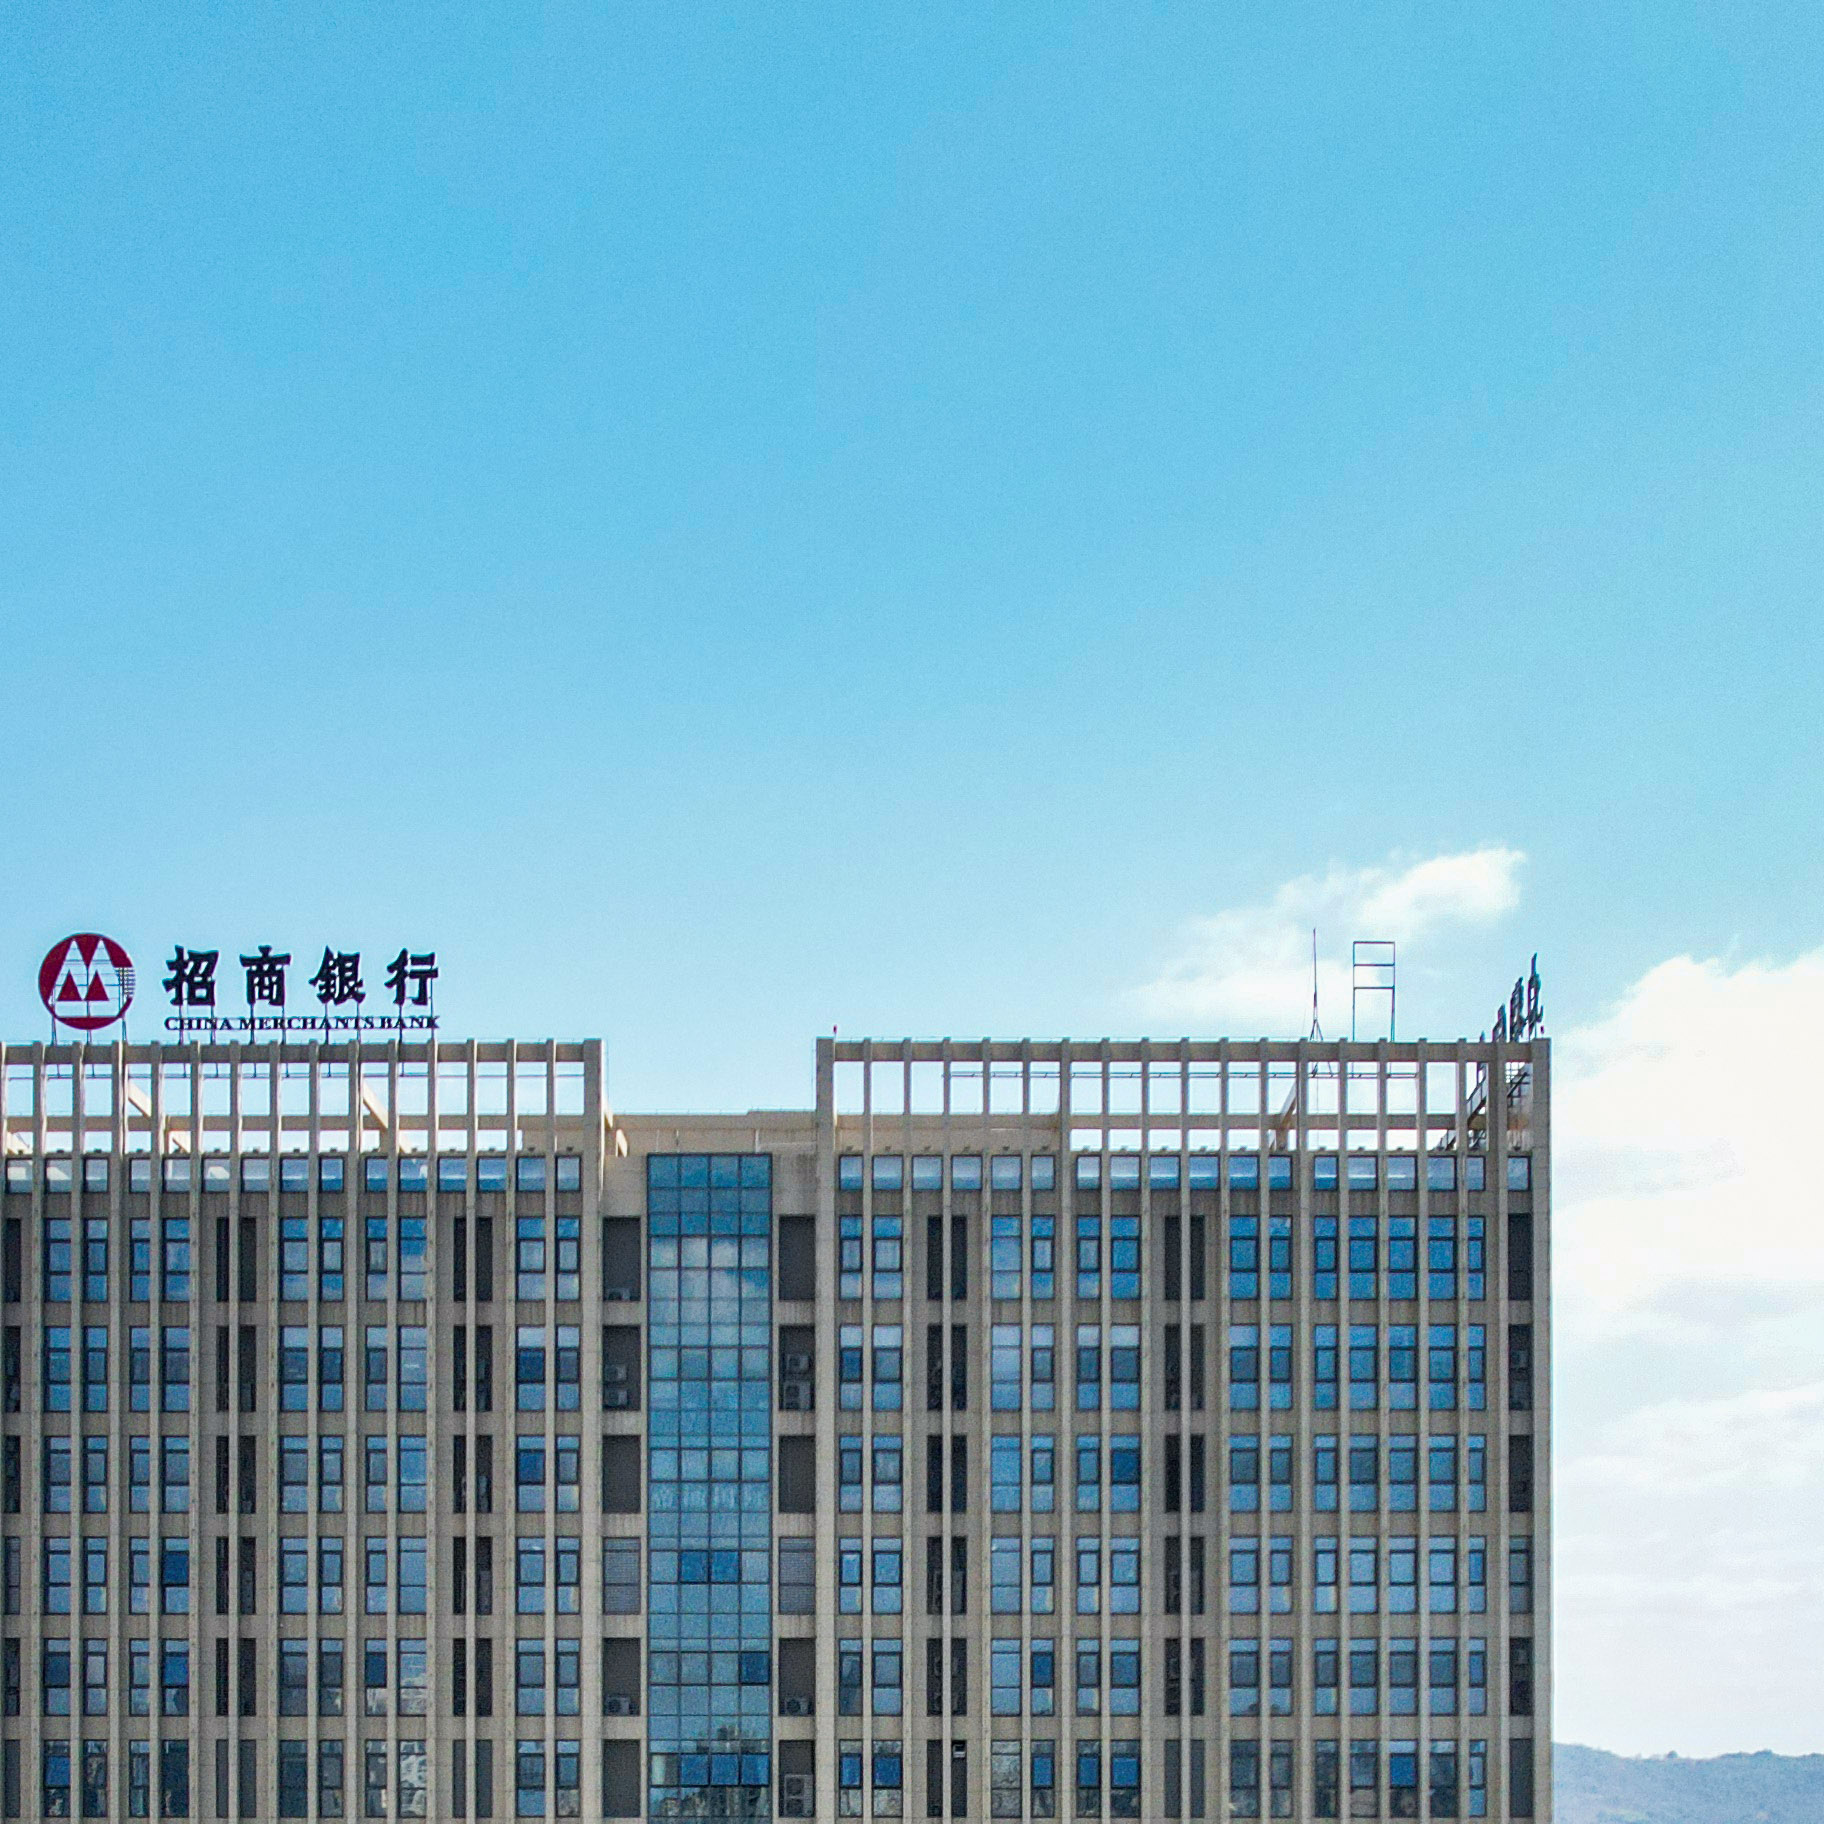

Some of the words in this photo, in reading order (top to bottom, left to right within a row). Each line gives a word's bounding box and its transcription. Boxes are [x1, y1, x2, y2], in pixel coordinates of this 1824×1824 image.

[164, 1016, 232, 1031] CHINA
[238, 1016, 375, 1031] MERCHANTS
[379, 1016, 441, 1031] BANK
